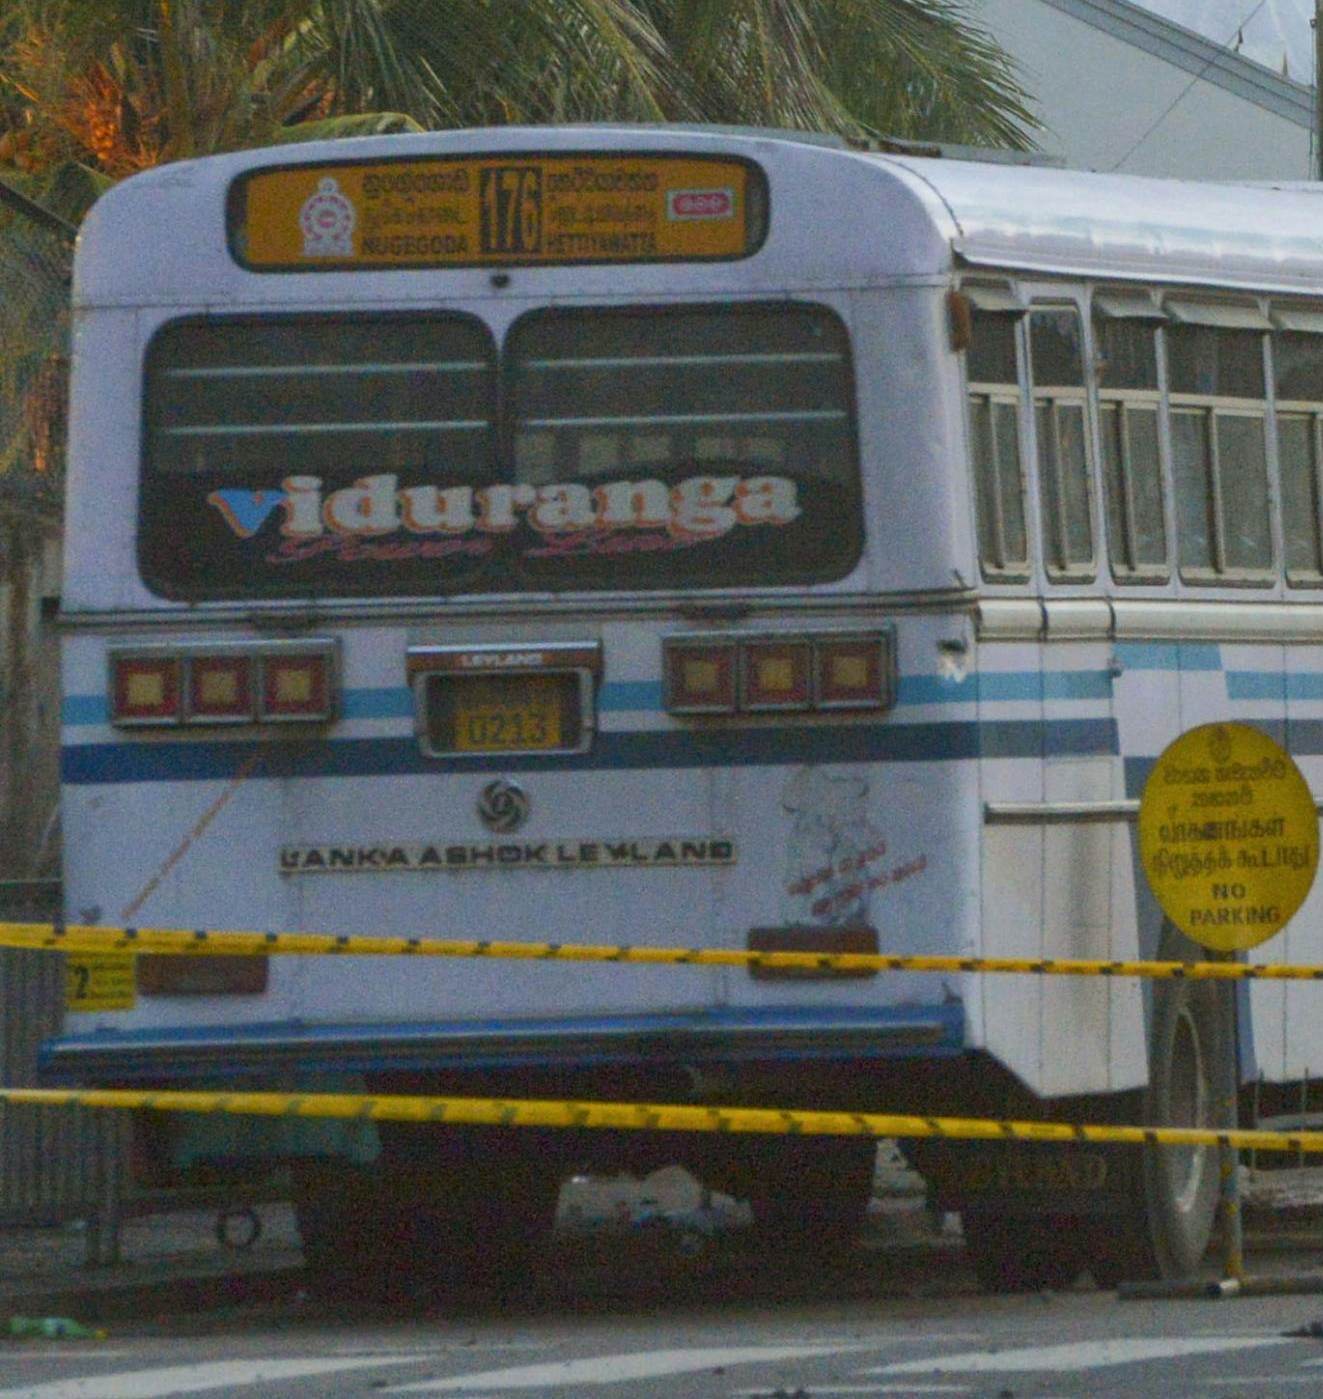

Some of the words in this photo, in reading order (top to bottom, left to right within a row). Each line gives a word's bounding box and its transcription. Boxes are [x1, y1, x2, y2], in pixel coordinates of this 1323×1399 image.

[207, 474, 801, 540] viduranga
[280, 848, 410, 868] LANKA
[418, 845, 547, 865] ASHOK
[556, 841, 734, 864] LEYLAND
[1212, 883, 1246, 900] NO
[1190, 905, 1281, 926] PARKING
